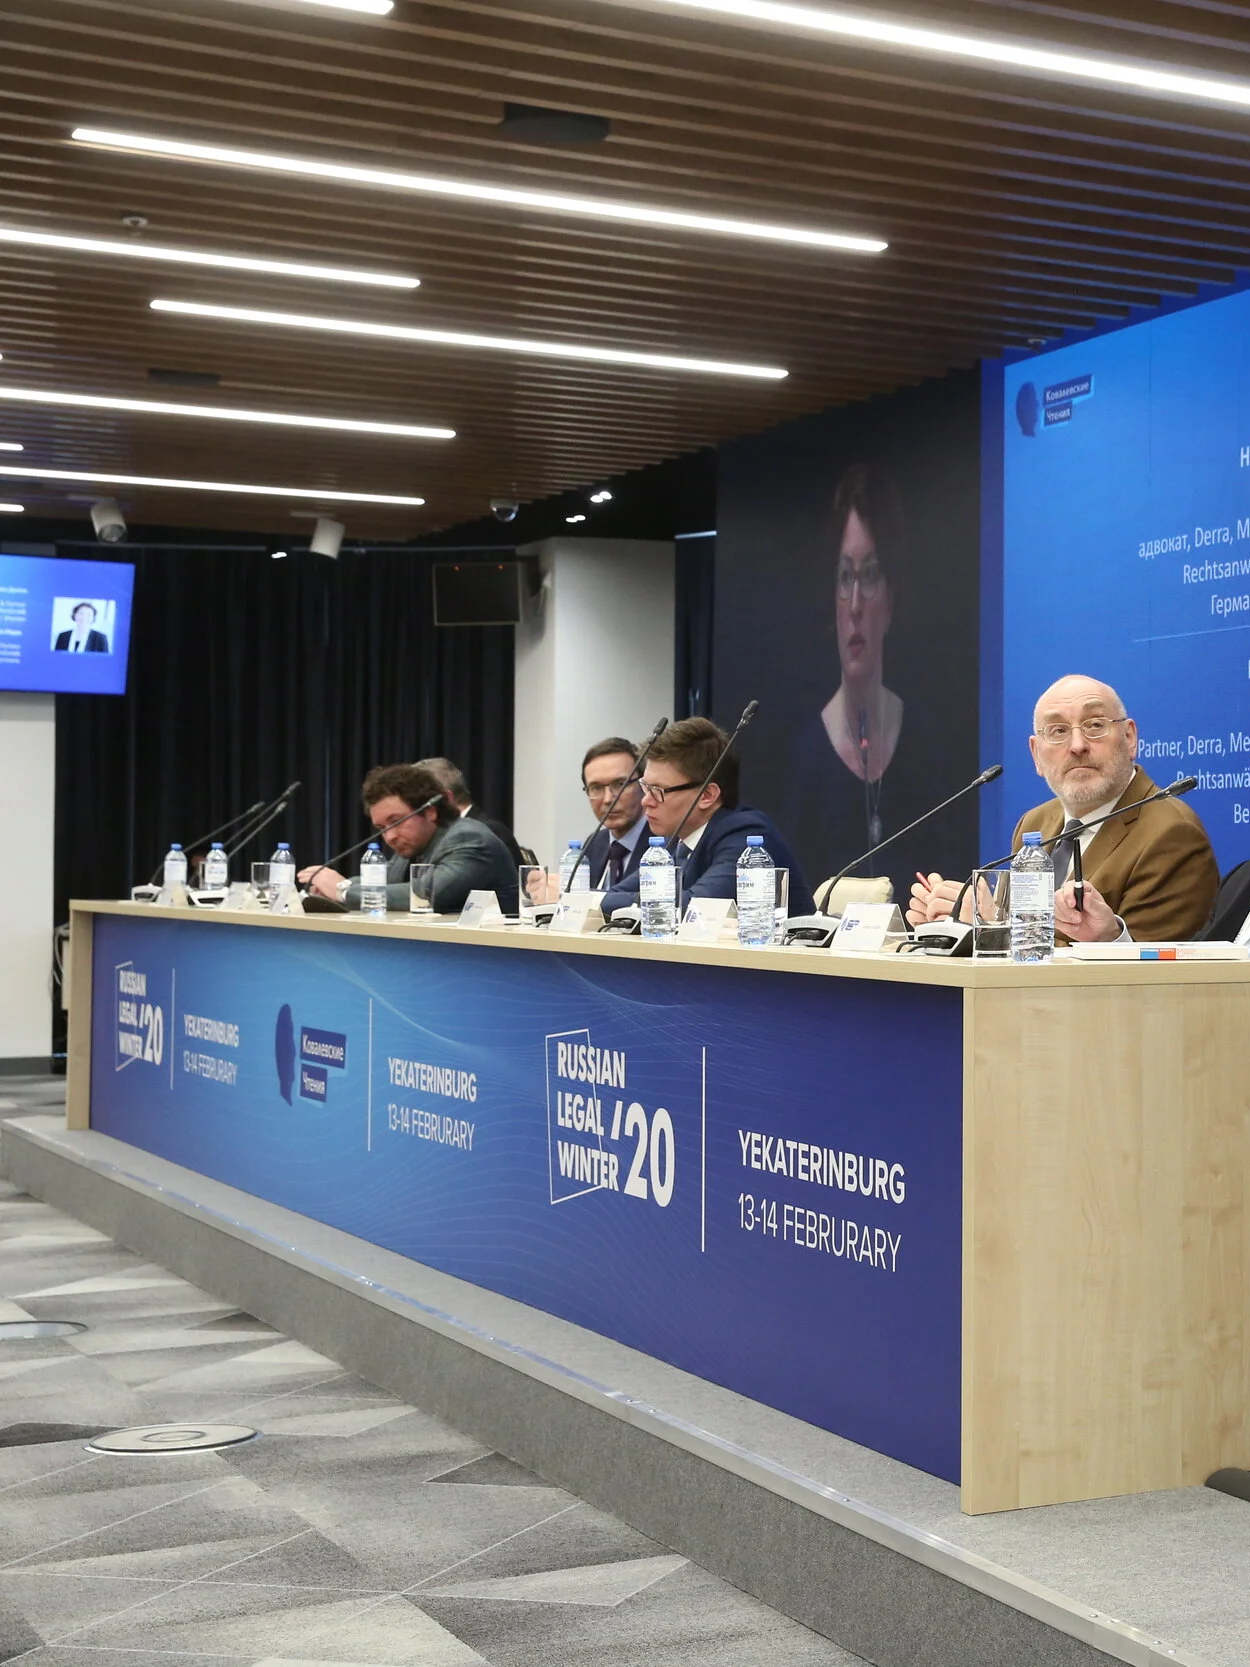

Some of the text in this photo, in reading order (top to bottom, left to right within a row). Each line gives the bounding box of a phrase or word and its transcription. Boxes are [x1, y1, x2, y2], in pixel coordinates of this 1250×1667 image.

[1045, 381, 1090, 402] Ковалевские
[1046, 408, 1071, 422] Чтения
[1138, 534, 1191, 560] адвокат,
[1195, 526, 1234, 548] Derra,
[1138, 739, 1184, 759] Partner,
[1187, 735, 1226, 757] Derra,
[119, 970, 146, 997] RUSSIAN
[119, 1000, 138, 1026] LEGAL
[119, 1030, 143, 1060] WINTER
[184, 1014, 239, 1048] YEKATERINBURG
[302, 1034, 344, 1061] Ковалевские
[388, 1057, 477, 1102] YEKATERINBURG
[557, 1042, 625, 1088] RUSSIAN
[302, 1071, 326, 1095] Чтения
[388, 1104, 475, 1151] 13-14 FEBRURARY
[557, 1091, 605, 1136] LEGAL
[557, 1140, 620, 1191] WINTER
[738, 1129, 905, 1204] YEKATERINBURG
[738, 1192, 901, 1272] 13-14 FEBRURARY
